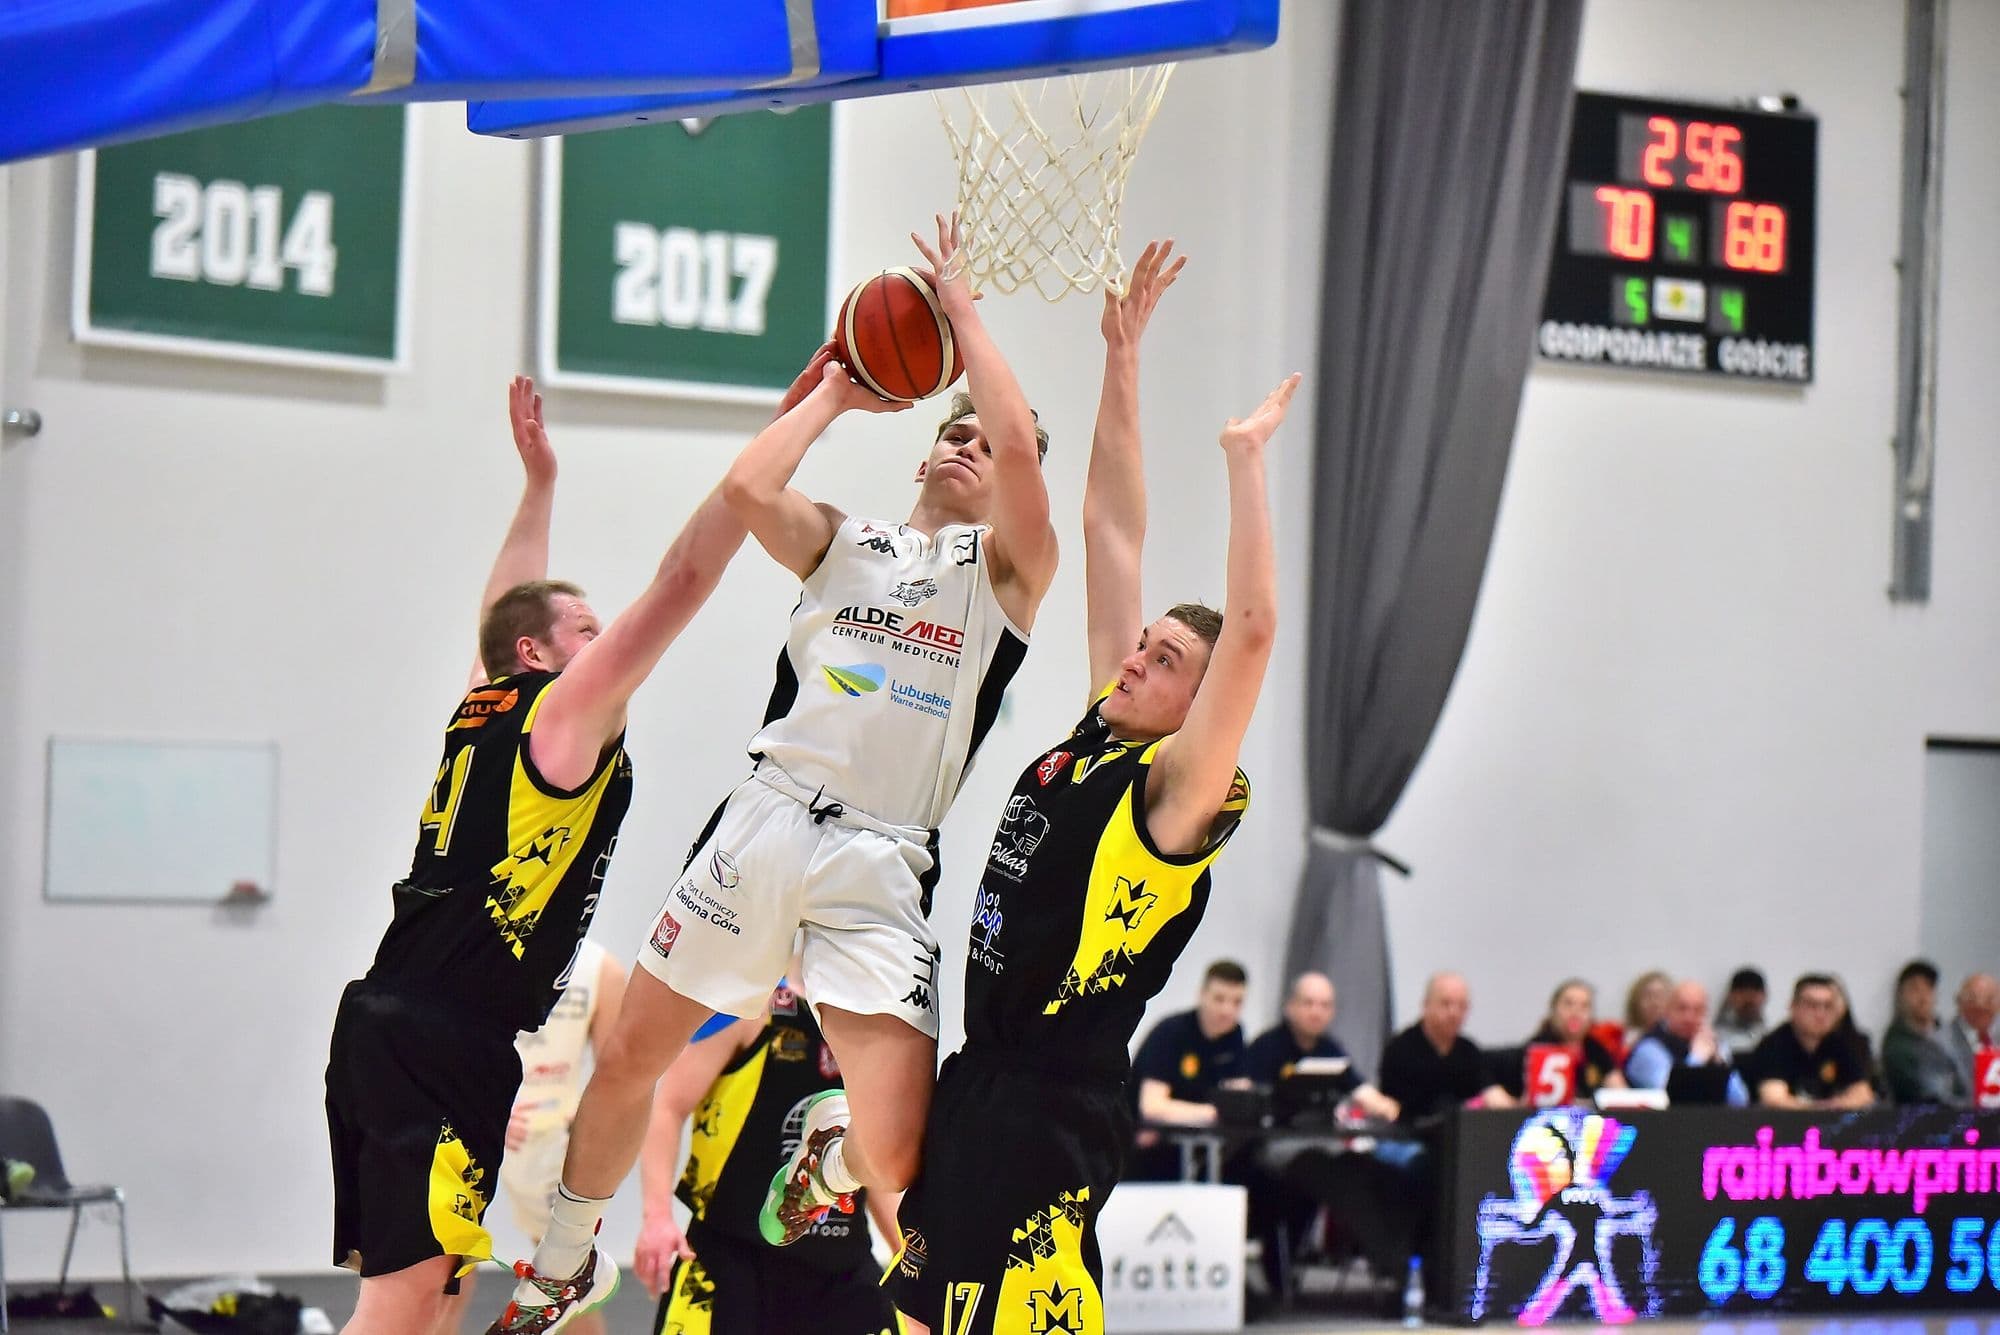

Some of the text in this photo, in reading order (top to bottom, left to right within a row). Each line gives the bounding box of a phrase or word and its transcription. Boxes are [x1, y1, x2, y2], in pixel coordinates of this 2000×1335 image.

[1643, 116, 1742, 193] 2 56
[151, 172, 336, 297] 2014
[1595, 186, 1786, 273] 70 4 68
[612, 223, 779, 335] 2017
[1624, 277, 1744, 333] 5 4
[1540, 321, 1707, 370] GOSPODARZE
[833, 606, 904, 632] ALDE
[832, 625, 960, 669] CENTRUM MEDYCZNE
[890, 693, 949, 720] Warte zachodu
[891, 679, 951, 710] Lubuskie
[676, 886, 741, 935] Zielona Góra
[687, 879, 738, 919] Port Lotniczy
[1537, 1054, 1571, 1105] 5
[1111, 1256, 1230, 1291] fatto
[1700, 1216, 1787, 1300] 68
[1805, 1217, 1934, 1295] 400
